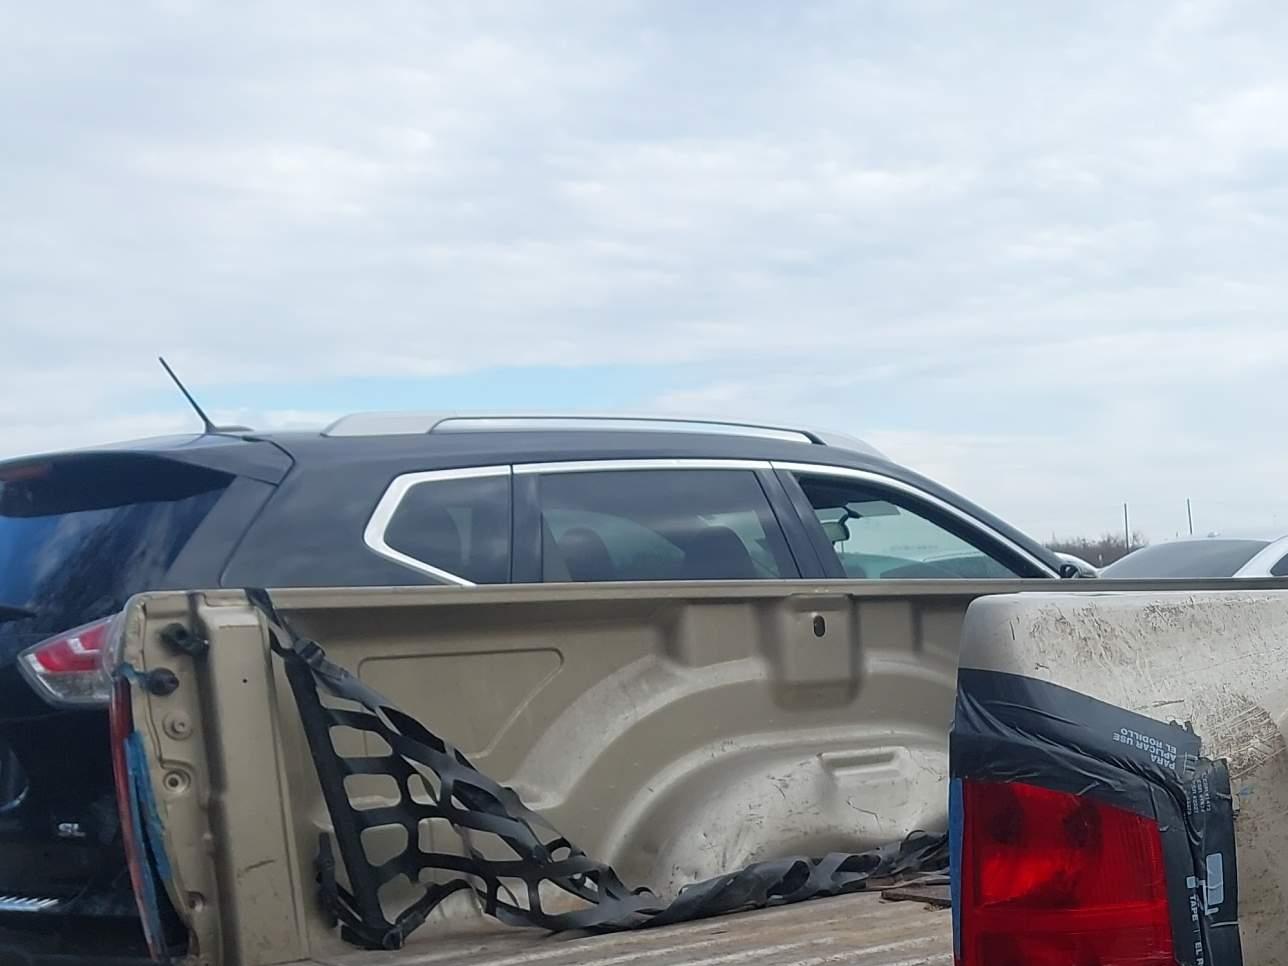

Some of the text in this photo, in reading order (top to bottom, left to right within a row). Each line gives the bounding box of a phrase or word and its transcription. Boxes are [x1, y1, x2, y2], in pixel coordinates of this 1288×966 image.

[1112, 732, 1176, 761] APLICAR USE
[1120, 728, 1177, 755] EL RODILLO
[1150, 753, 1176, 770] PARA
[1190, 894, 1199, 921] TAPE
[1195, 942, 1202, 955] EL
